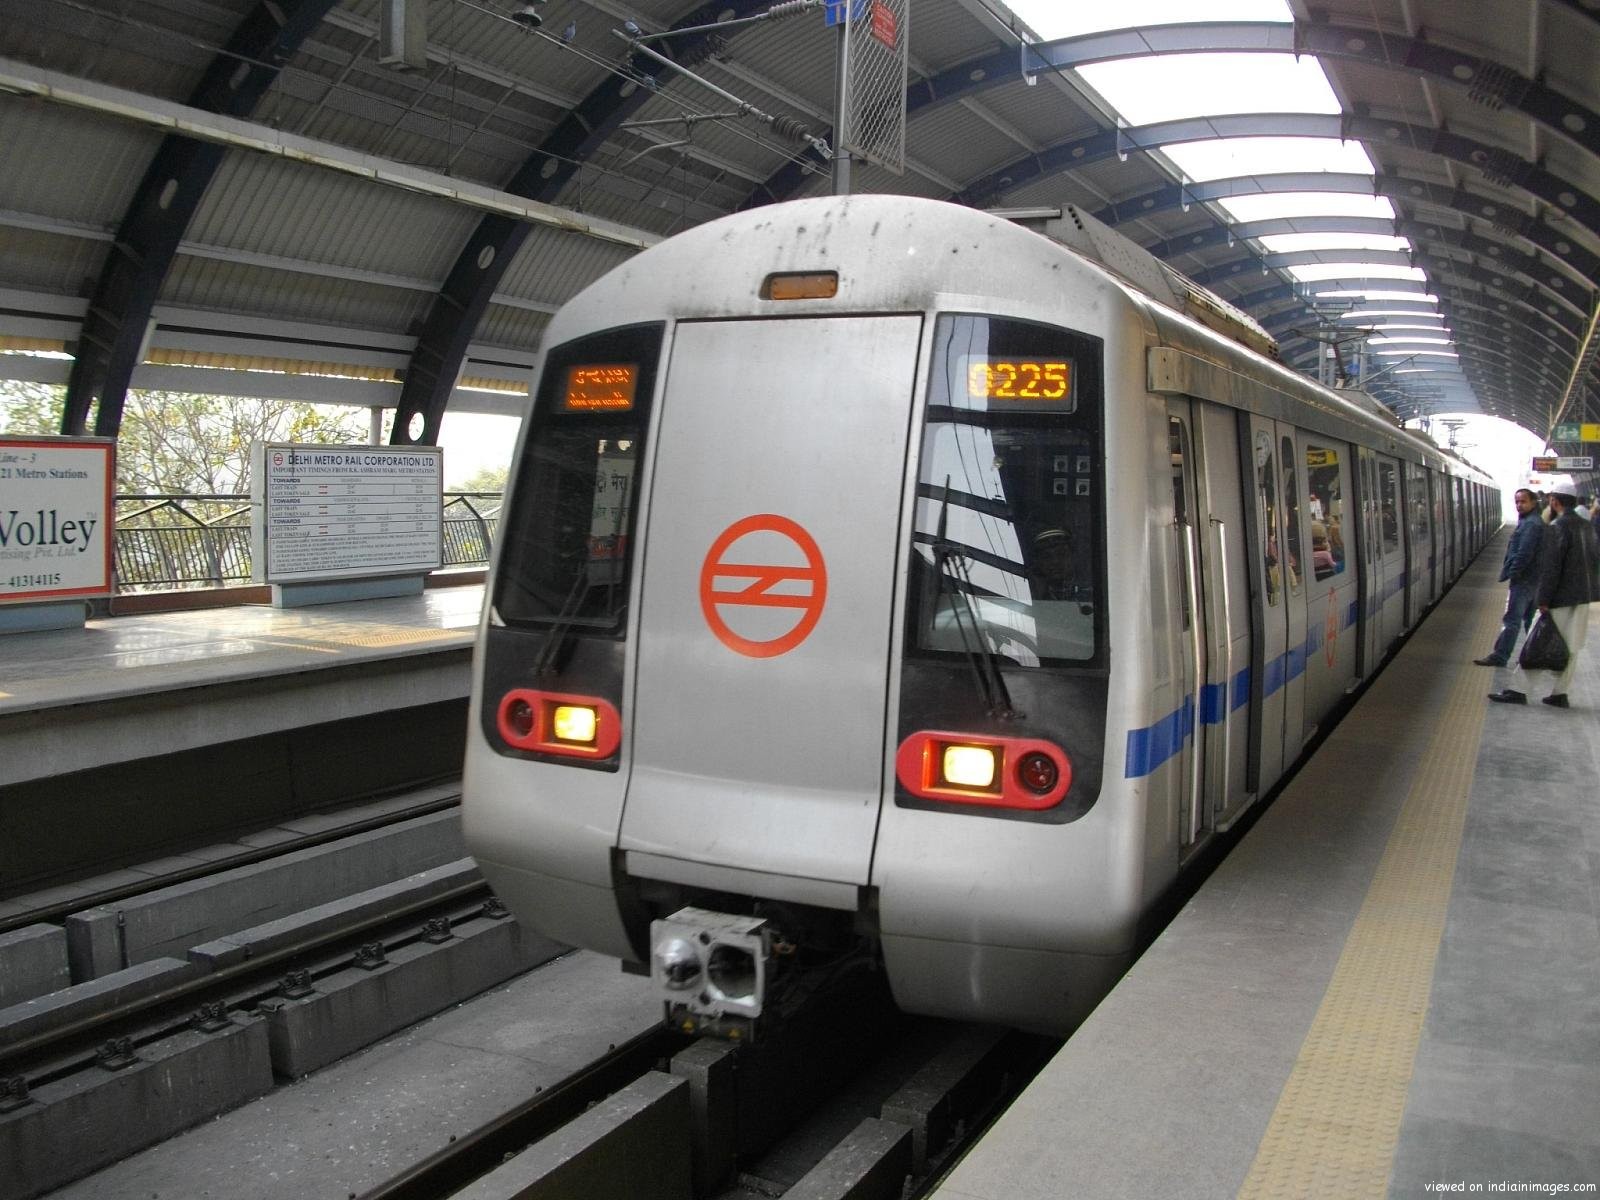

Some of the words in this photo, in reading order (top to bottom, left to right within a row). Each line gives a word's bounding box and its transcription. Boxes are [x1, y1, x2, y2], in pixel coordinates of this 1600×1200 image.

[288, 455, 312, 465] DELHI
[314, 455, 343, 465] METRO
[345, 456, 362, 465] RAIL
[364, 456, 420, 466] CORPORATION
[16, 468, 47, 479] Metro
[50, 468, 88, 479] Stations
[9, 573, 61, 587] 41314115
